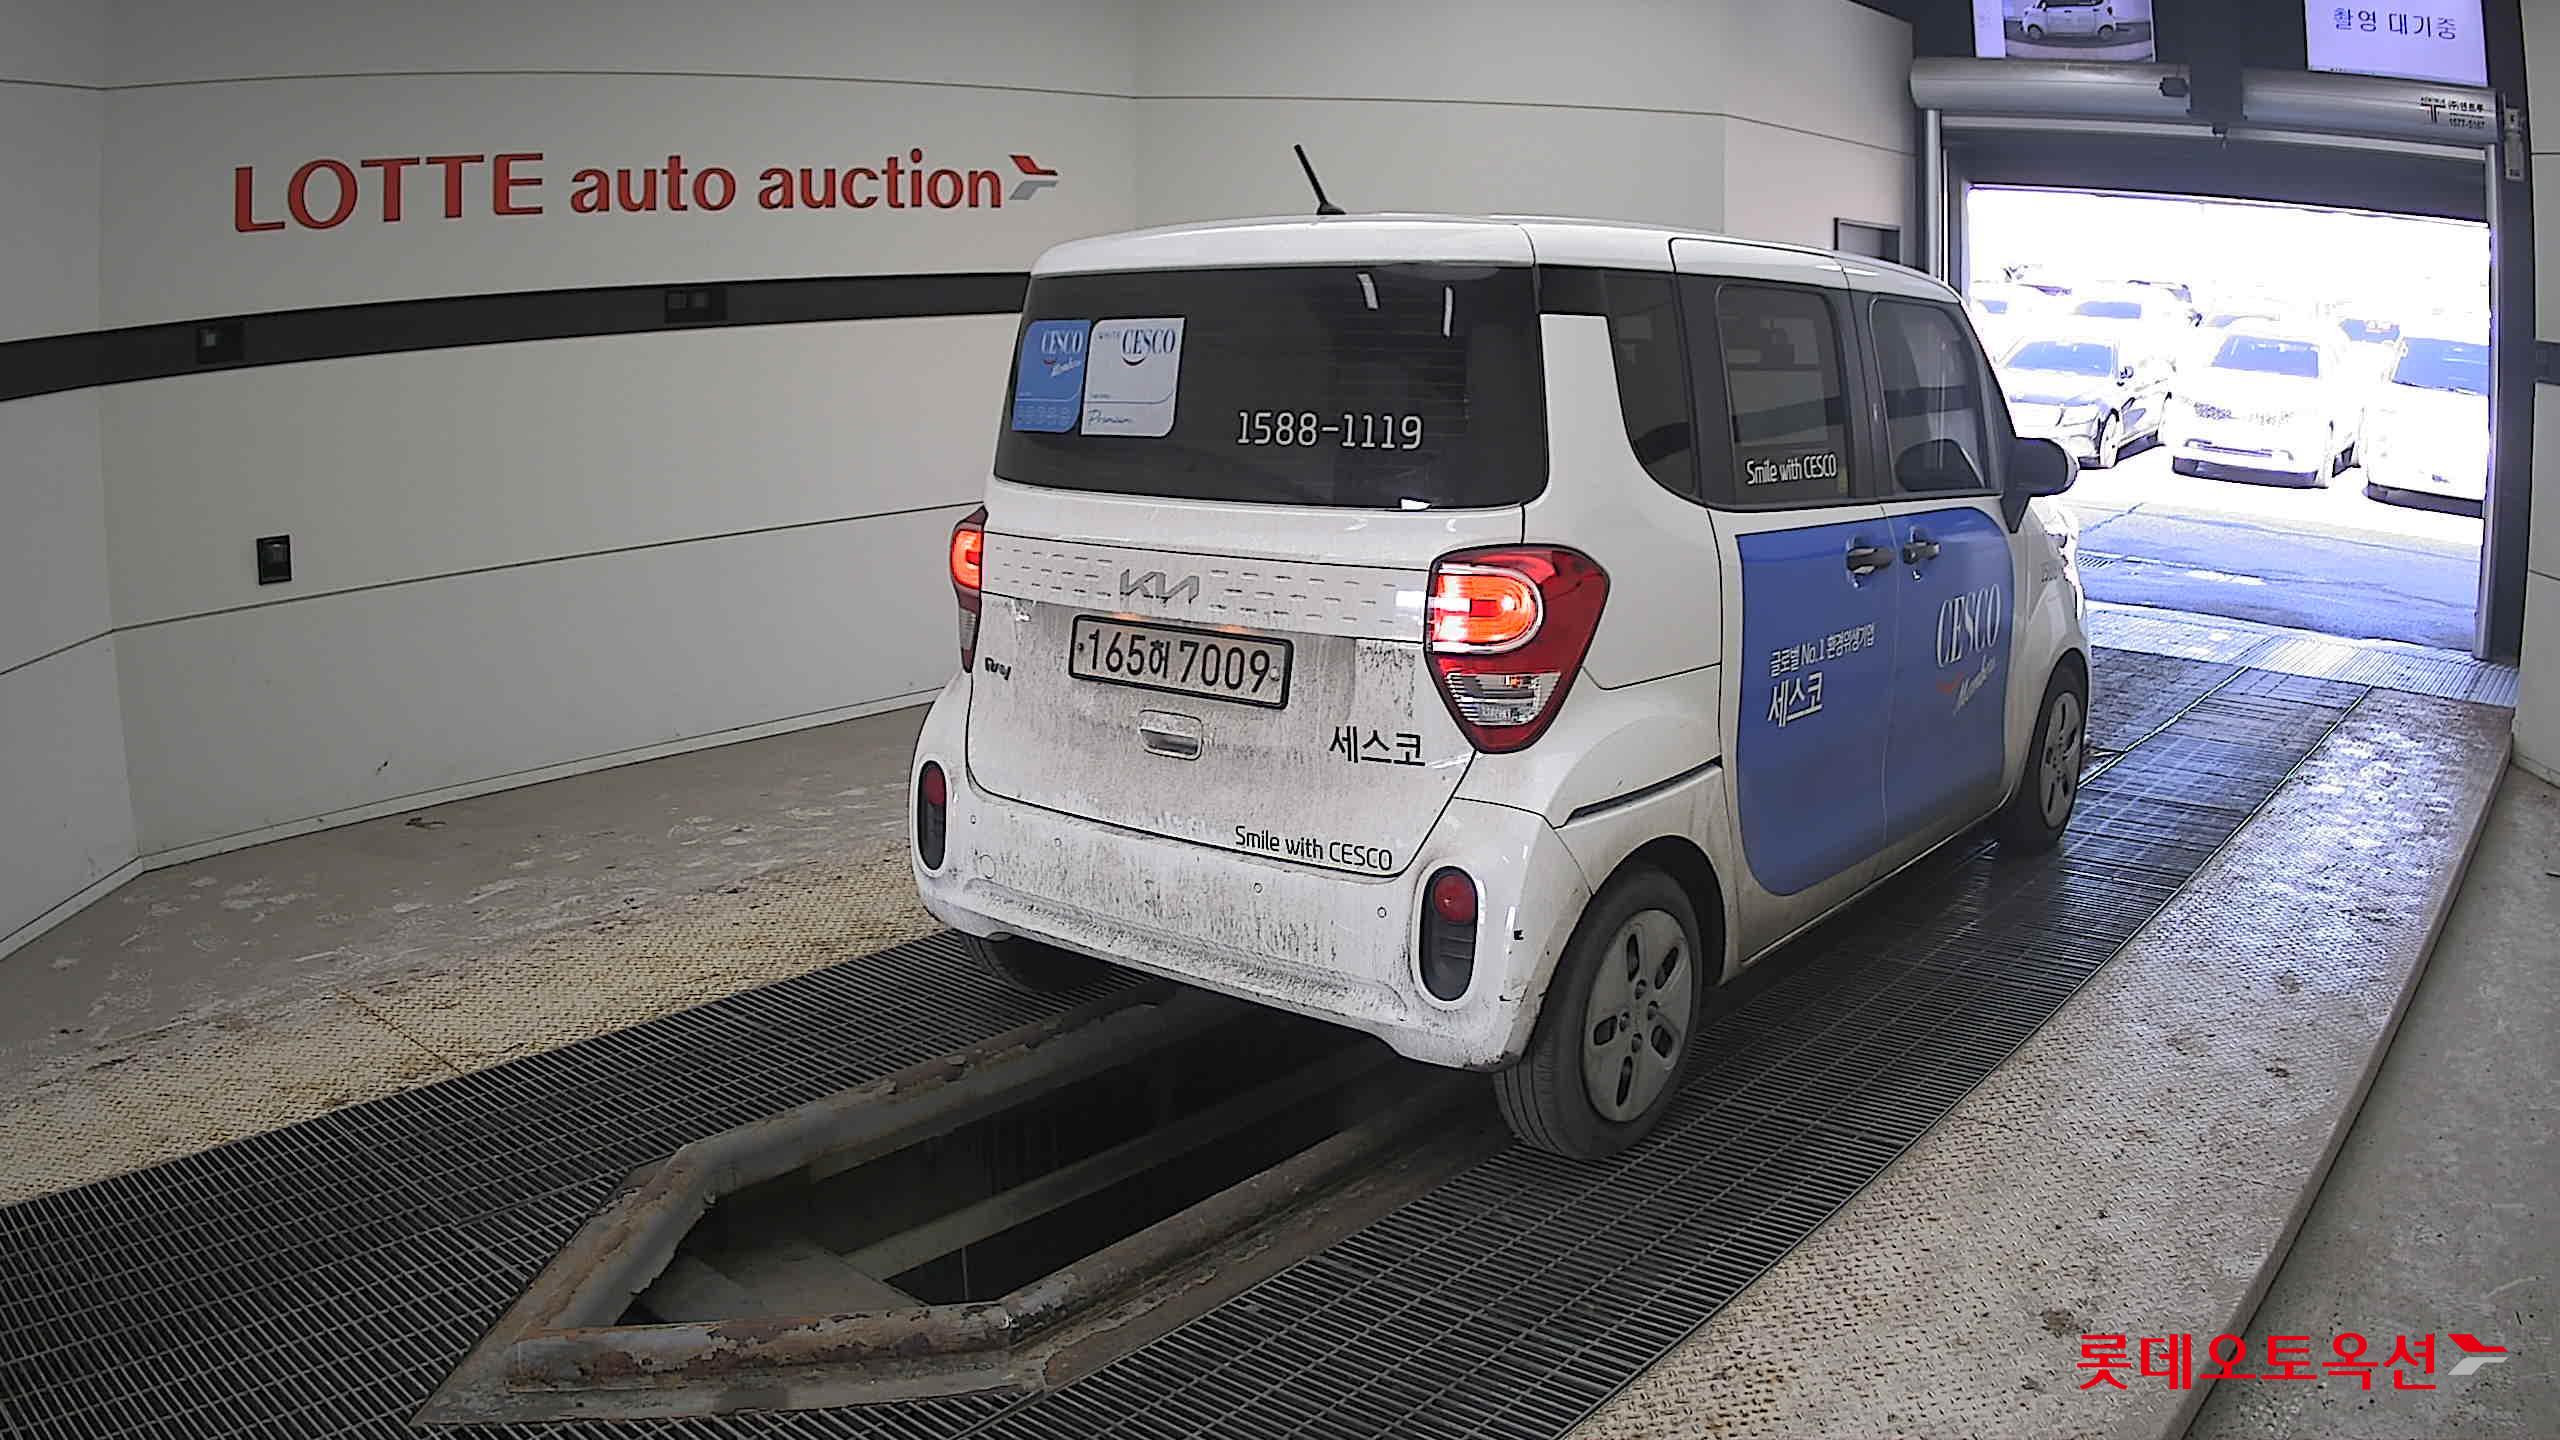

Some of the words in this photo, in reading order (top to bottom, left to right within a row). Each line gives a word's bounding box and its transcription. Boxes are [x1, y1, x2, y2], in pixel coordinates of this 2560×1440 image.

[2389, 13, 2457, 40] 대기중
[235, 153, 544, 232] LOTTE
[570, 155, 736, 214] auto
[759, 147, 1003, 210] auction
[1041, 329, 1083, 355] CESCO
[1121, 328, 1176, 355] CESCO
[1237, 411, 1424, 450] 1588-1119
[1747, 460, 1777, 485] Smile
[1780, 457, 1802, 481] with
[1803, 454, 1837, 479] CESCO
[1936, 584, 2000, 669] CESCO
[1088, 629, 1171, 679] 165허
[1179, 639, 1271, 693] 7009
[1801, 638, 1825, 666] No.1
[1767, 671, 1824, 728] 세스코
[1329, 725, 1426, 767] 세스코
[1235, 825, 1280, 852] Smile
[1284, 836, 1324, 860] with
[1329, 841, 1393, 871] CESCO
